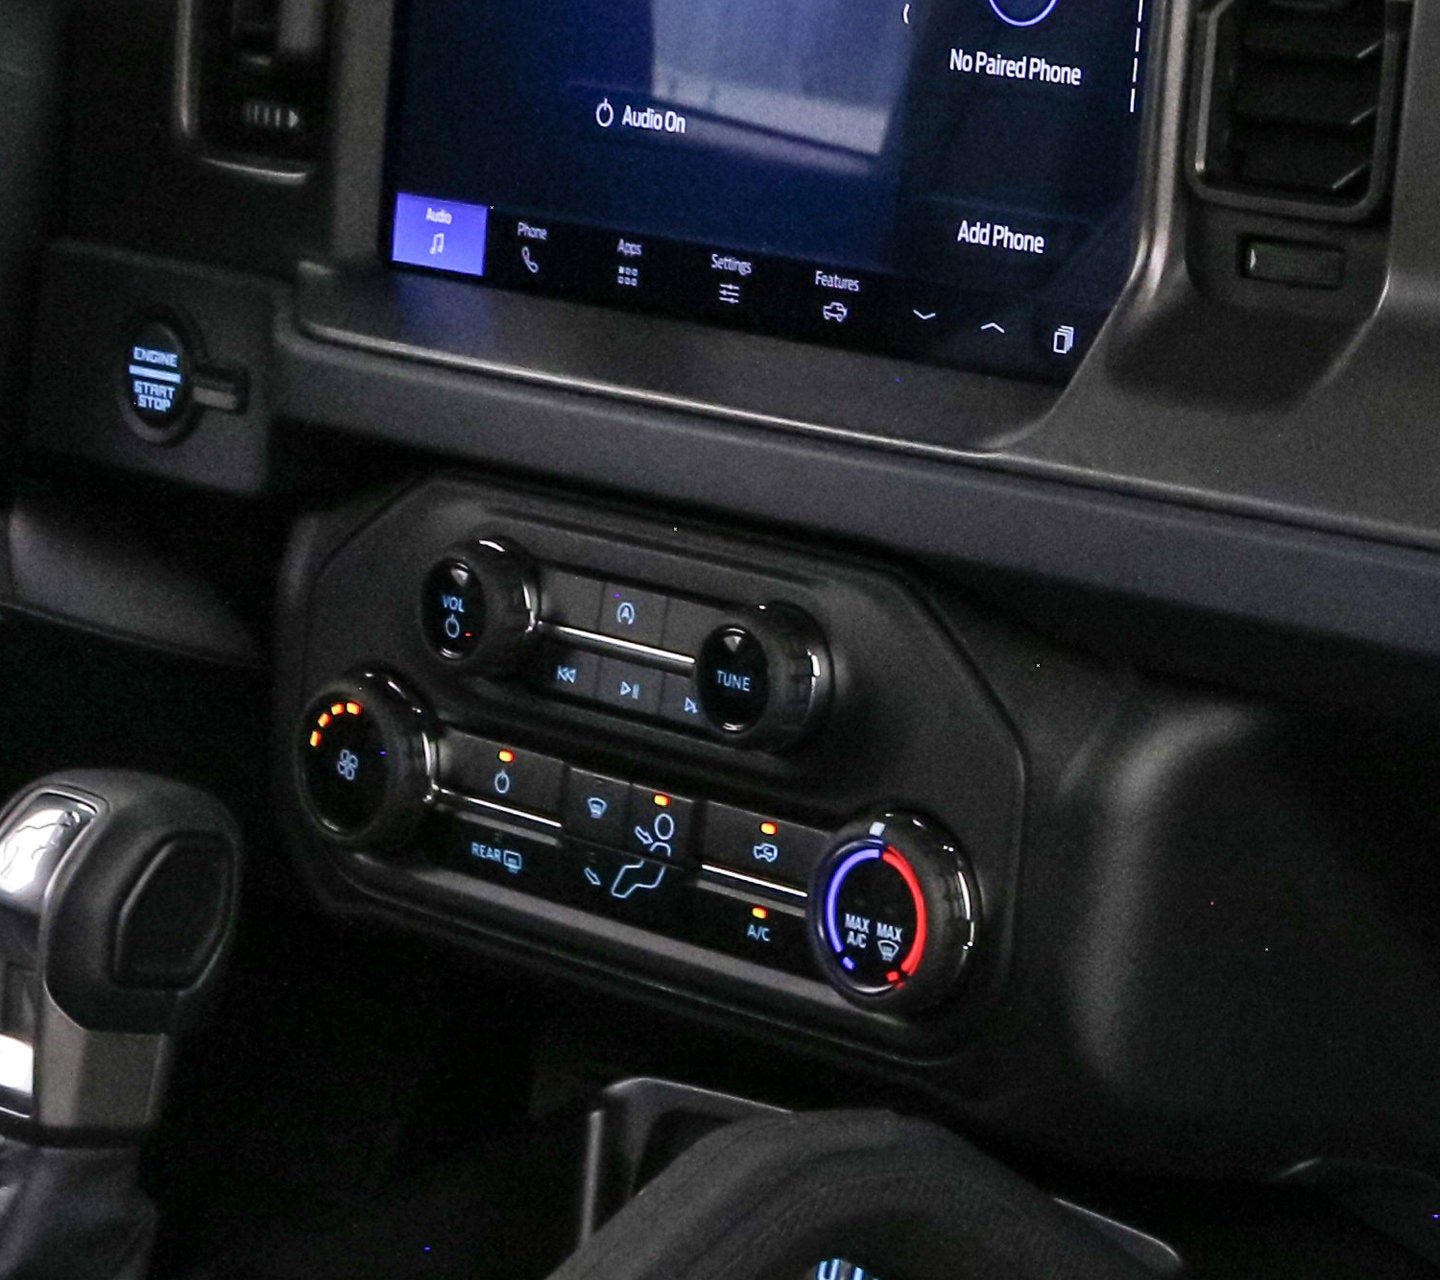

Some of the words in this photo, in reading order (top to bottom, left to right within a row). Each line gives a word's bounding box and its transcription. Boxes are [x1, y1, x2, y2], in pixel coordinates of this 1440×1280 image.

[949, 48, 973, 72] No
[974, 50, 1026, 80] Paired
[1028, 57, 1082, 86] Phone
[621, 104, 664, 131] Audio
[664, 110, 687, 134] On
[424, 206, 454, 226] Audio
[516, 220, 549, 241] Phone
[956, 219, 992, 248] Add
[993, 223, 1046, 255] Phone
[616, 236, 644, 259] Apps
[710, 251, 753, 277] Settings
[814, 268, 861, 293] Features
[132, 345, 179, 368] ENGINE
[133, 380, 176, 401] START
[137, 394, 171, 412] STOP
[442, 595, 466, 615] VOL
[716, 669, 751, 693] TUNE
[471, 841, 502, 863] REAR
[746, 923, 771, 943] A/C
[844, 913, 870, 933] MAX
[876, 922, 902, 943] MAX
[846, 930, 870, 949] A/C
